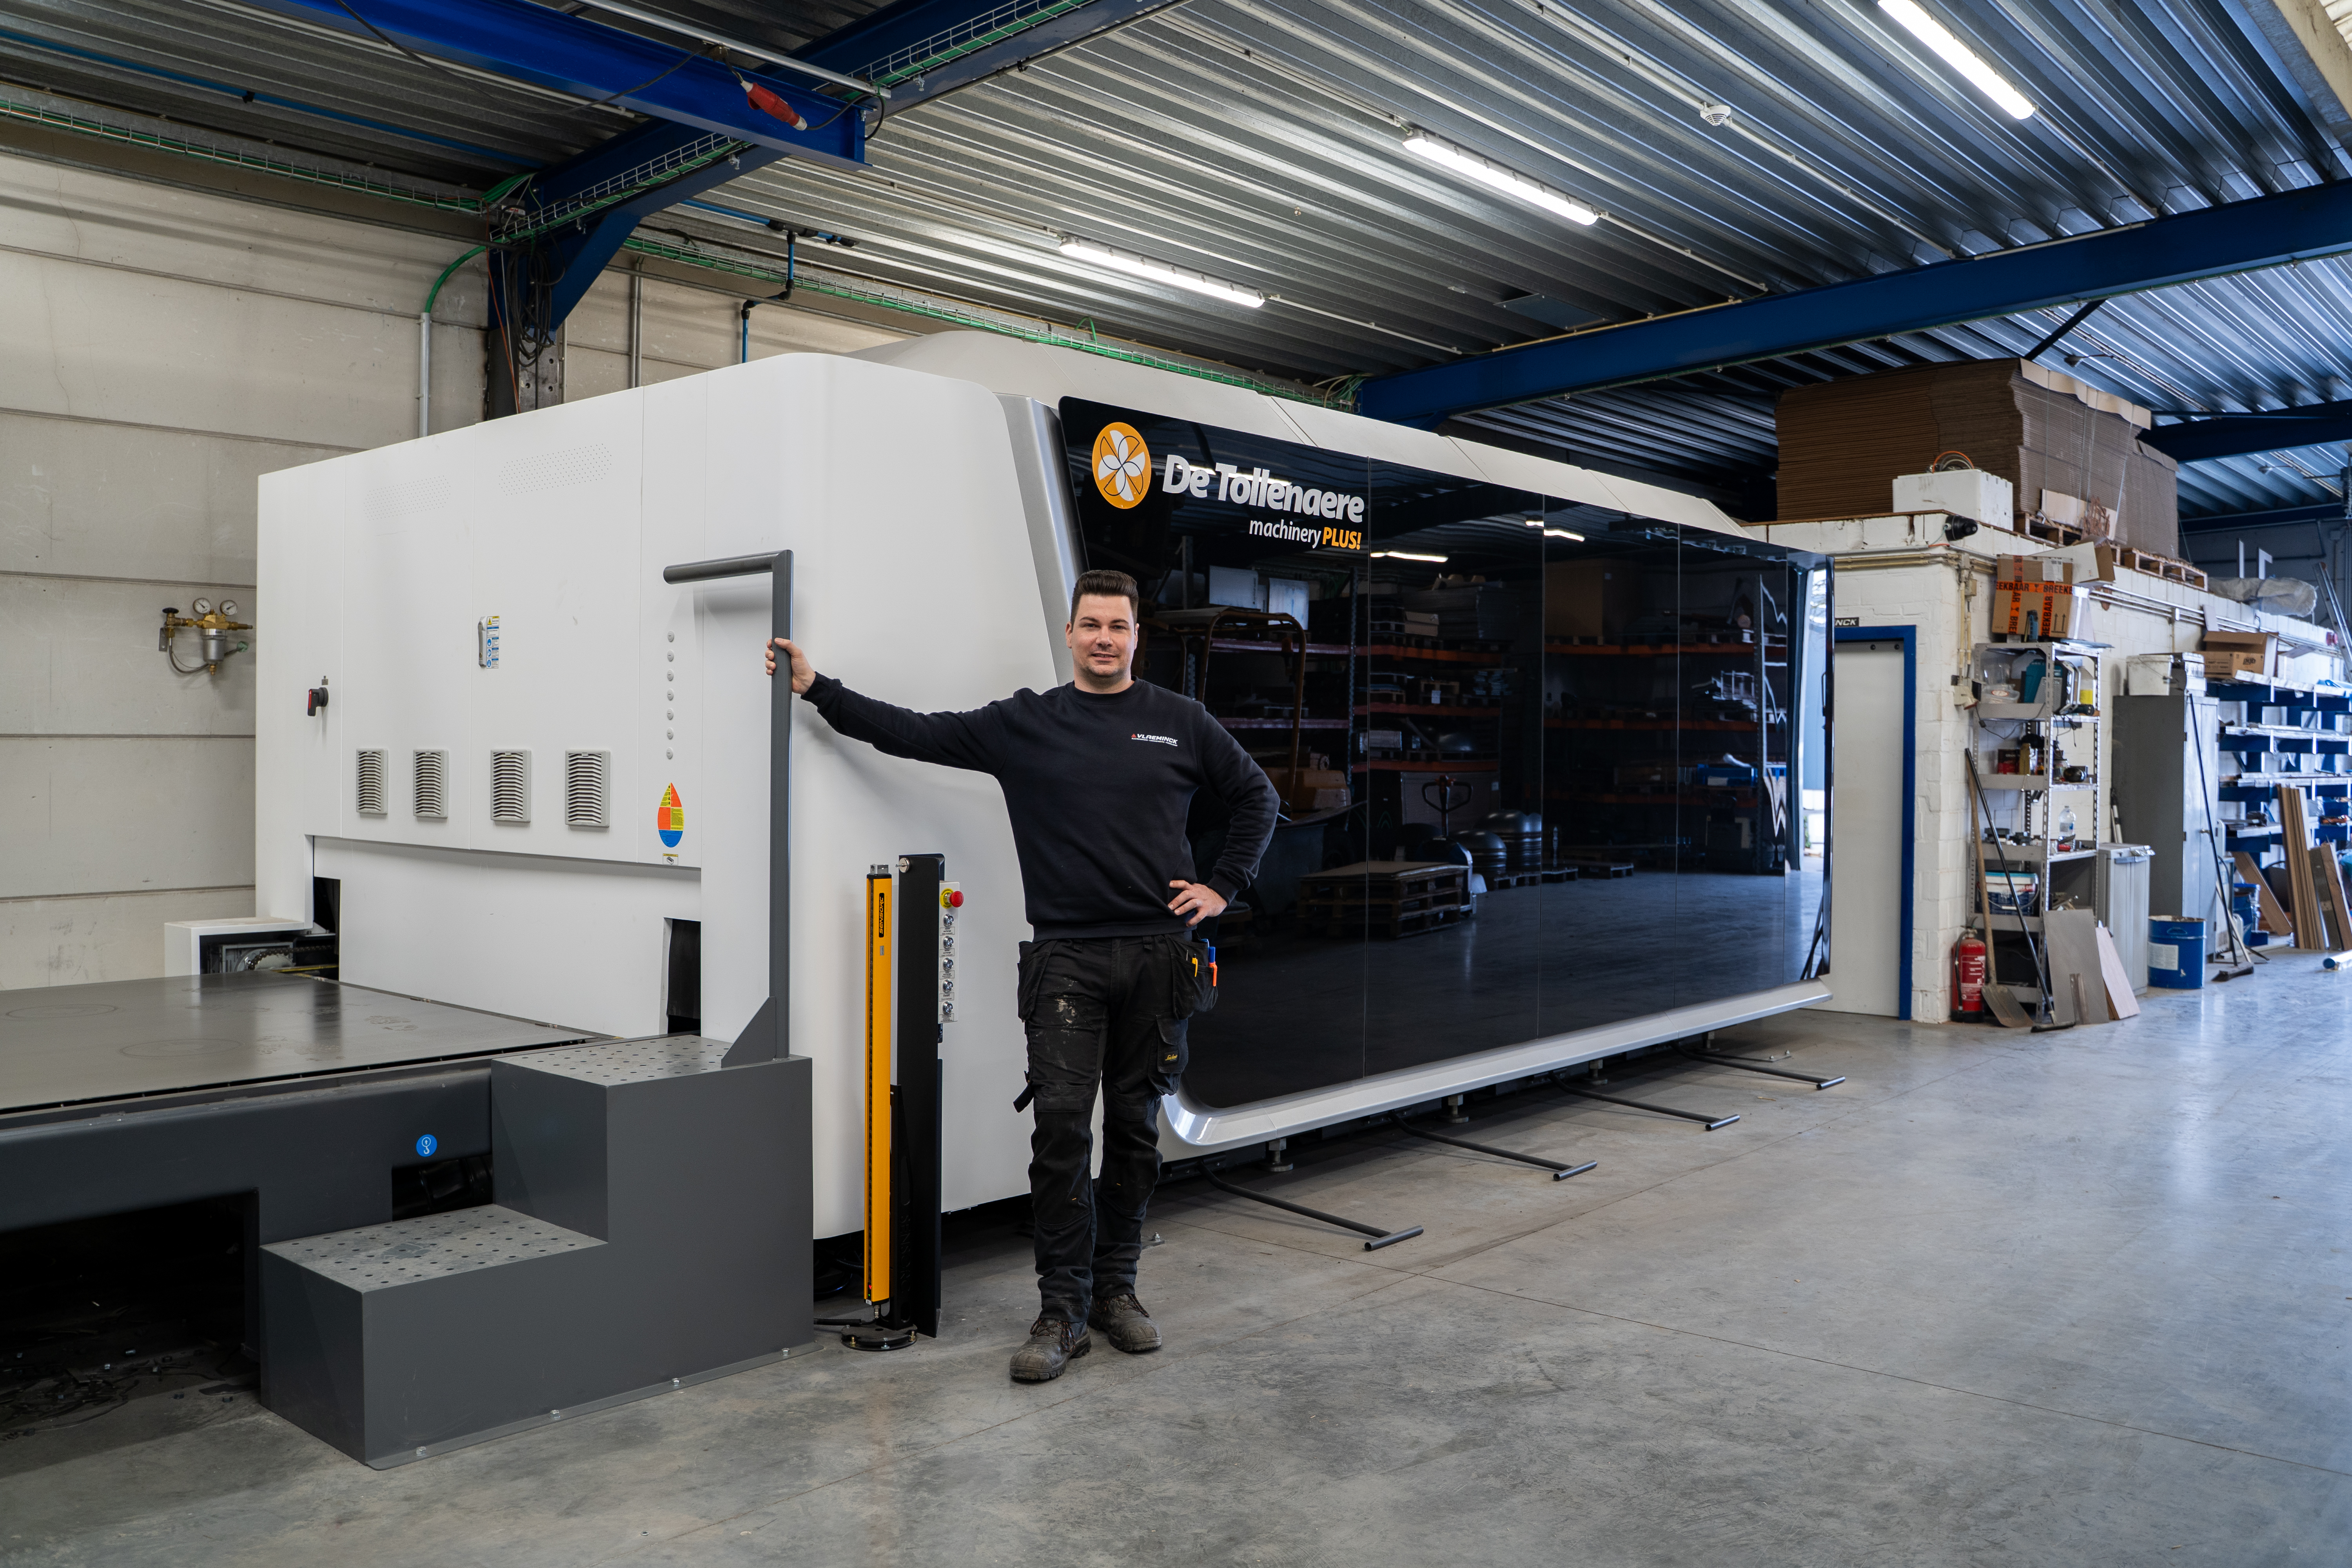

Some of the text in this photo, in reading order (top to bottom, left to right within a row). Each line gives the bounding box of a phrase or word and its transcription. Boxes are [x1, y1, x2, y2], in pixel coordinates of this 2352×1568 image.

[1163, 455, 1365, 523] De Tollenaere
[1250, 519, 1362, 550] machinery PLUS!
[1137, 733, 1178, 744] VLAEMINCK
